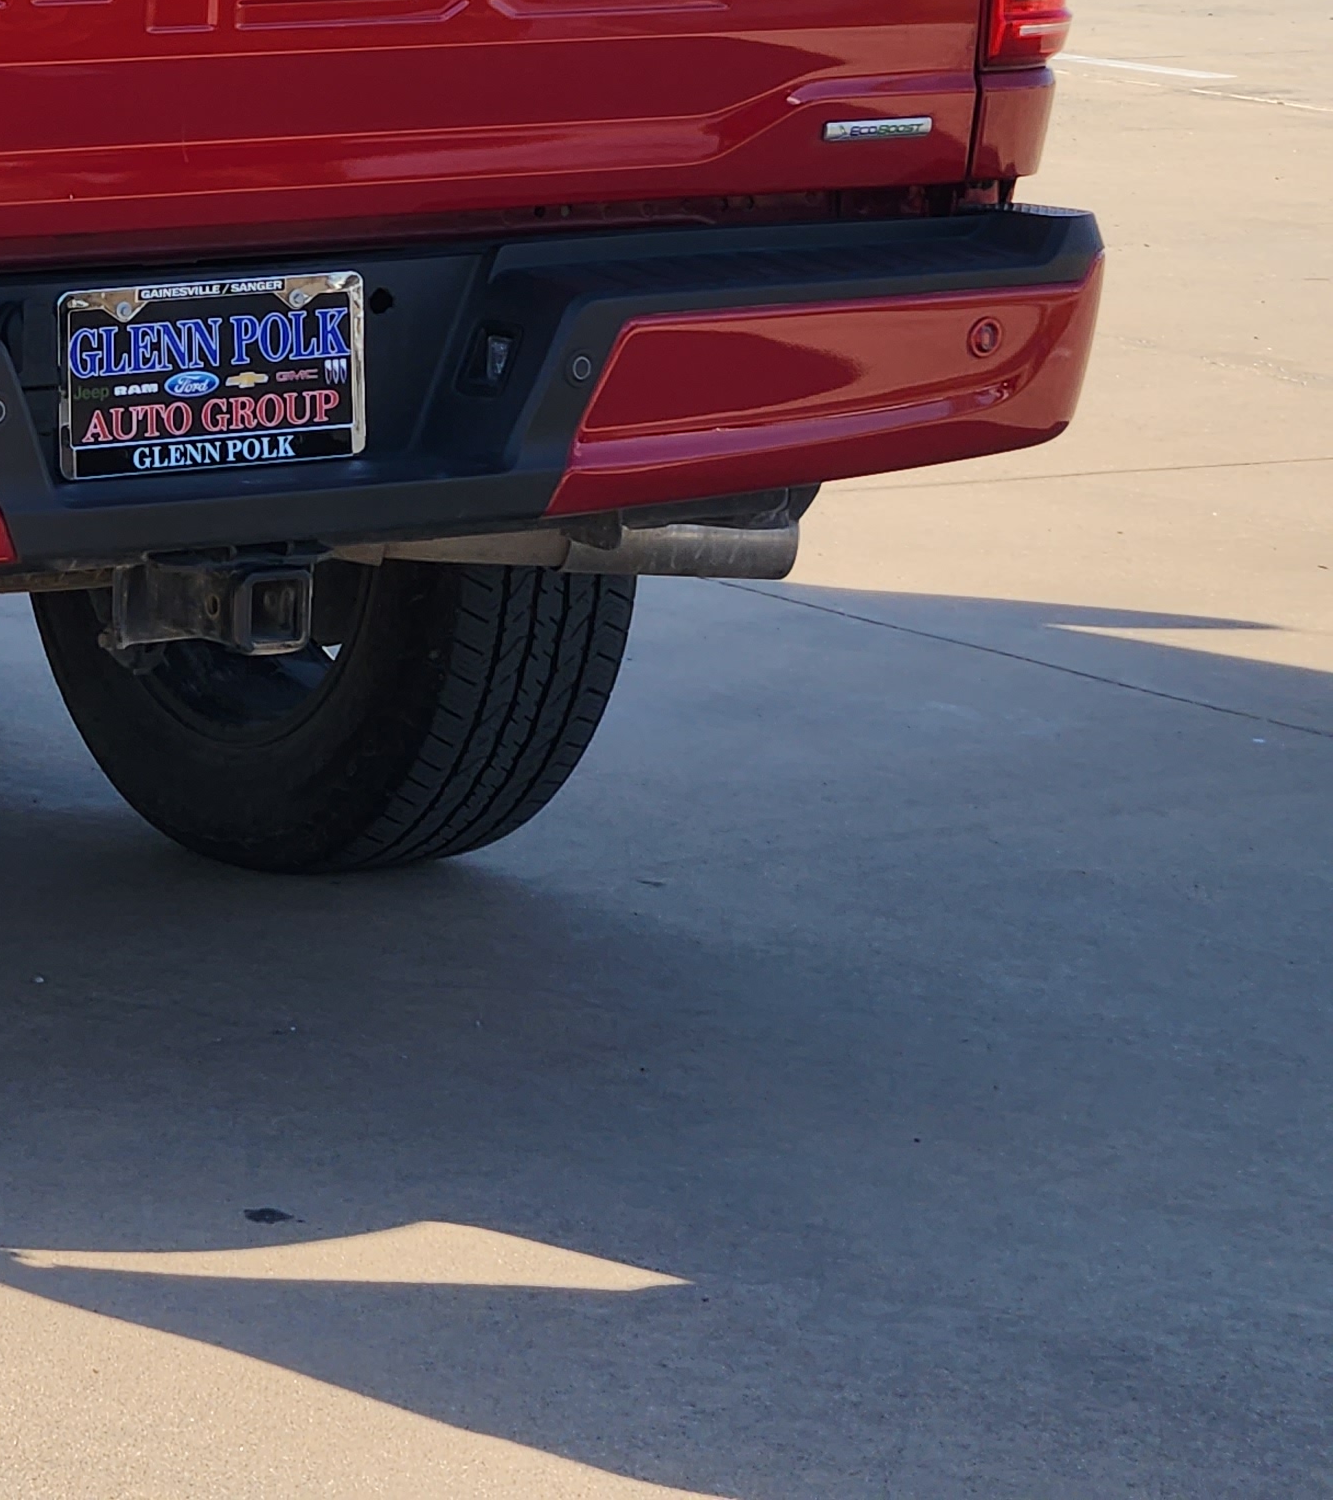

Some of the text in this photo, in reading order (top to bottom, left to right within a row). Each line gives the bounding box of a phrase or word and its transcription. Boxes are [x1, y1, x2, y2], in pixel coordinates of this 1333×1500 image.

[69, 307, 352, 379] GLENN POLK
[174, 375, 210, 394] Ford
[275, 368, 319, 383] GMC
[73, 384, 110, 402] Jeep
[114, 382, 159, 397] RAM
[81, 390, 340, 443] AUTO GROUP
[132, 435, 296, 470] GLENN POLK
